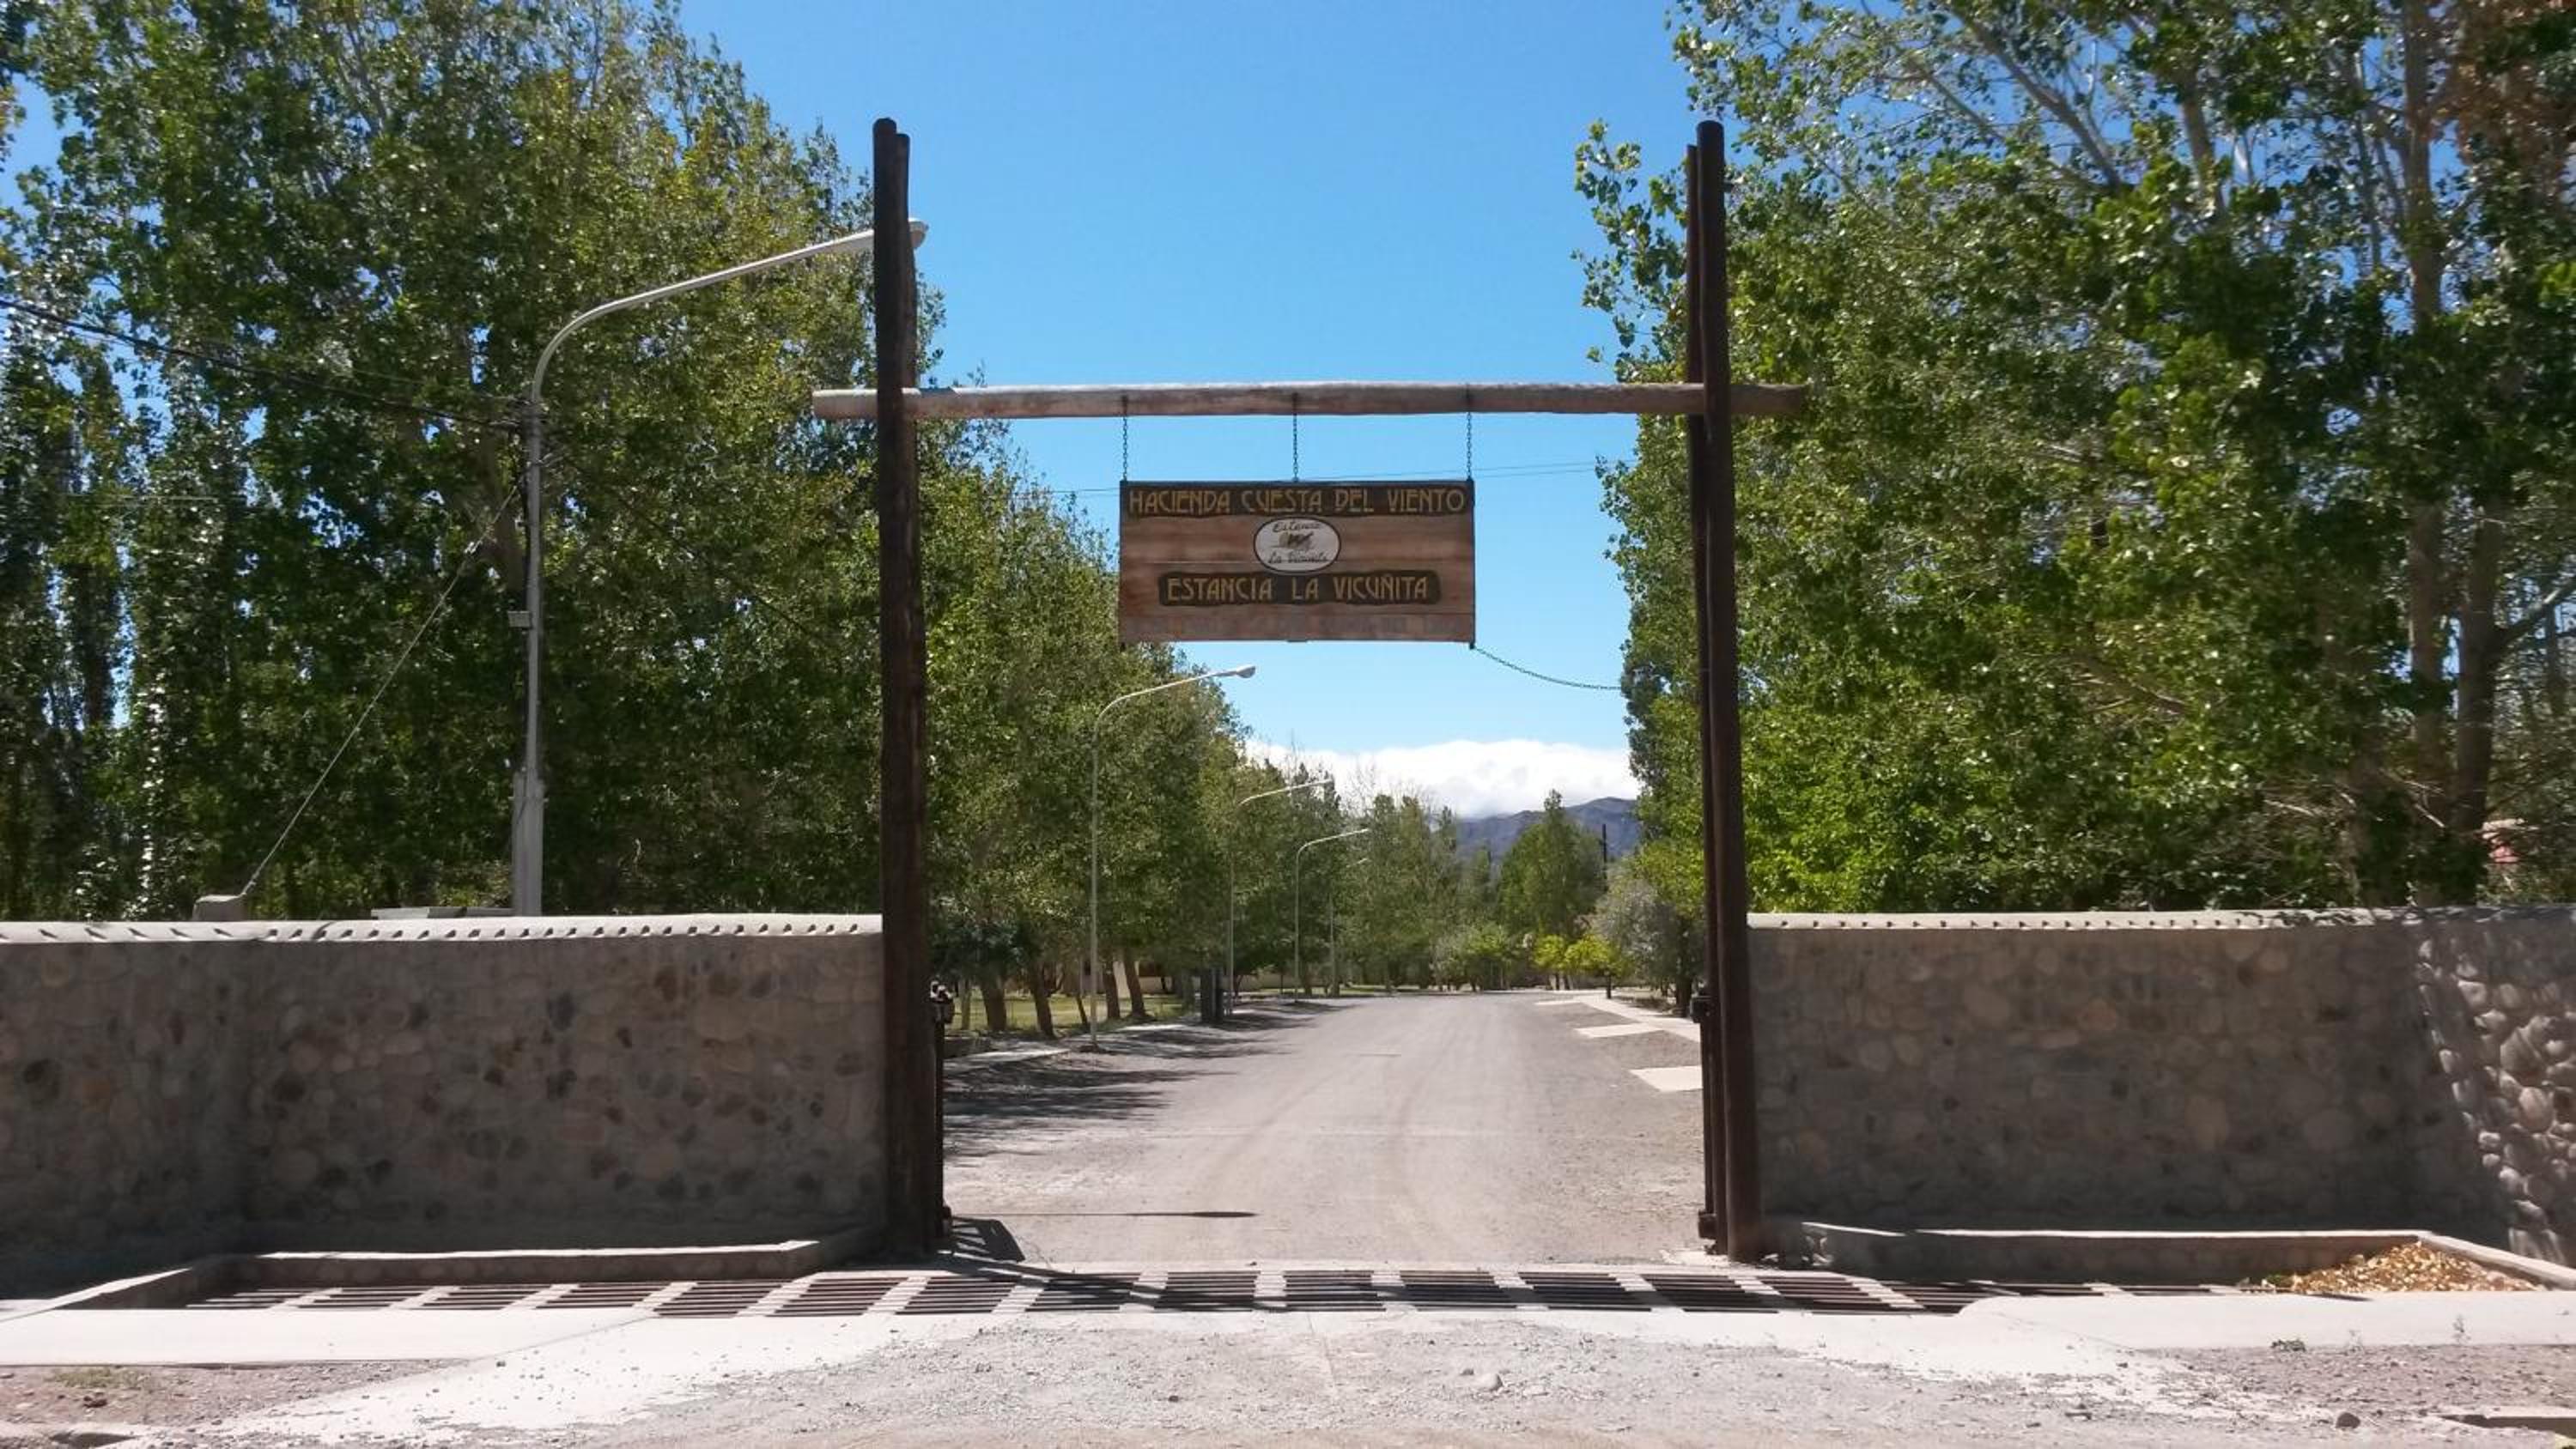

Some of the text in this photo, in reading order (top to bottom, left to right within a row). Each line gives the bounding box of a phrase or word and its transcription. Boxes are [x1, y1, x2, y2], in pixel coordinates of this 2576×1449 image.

[1128, 487, 1466, 514] HACIENDA CUESTA DEL VIENTO
[1167, 573, 1427, 602] ESTANCIA LA VICUÑITA
